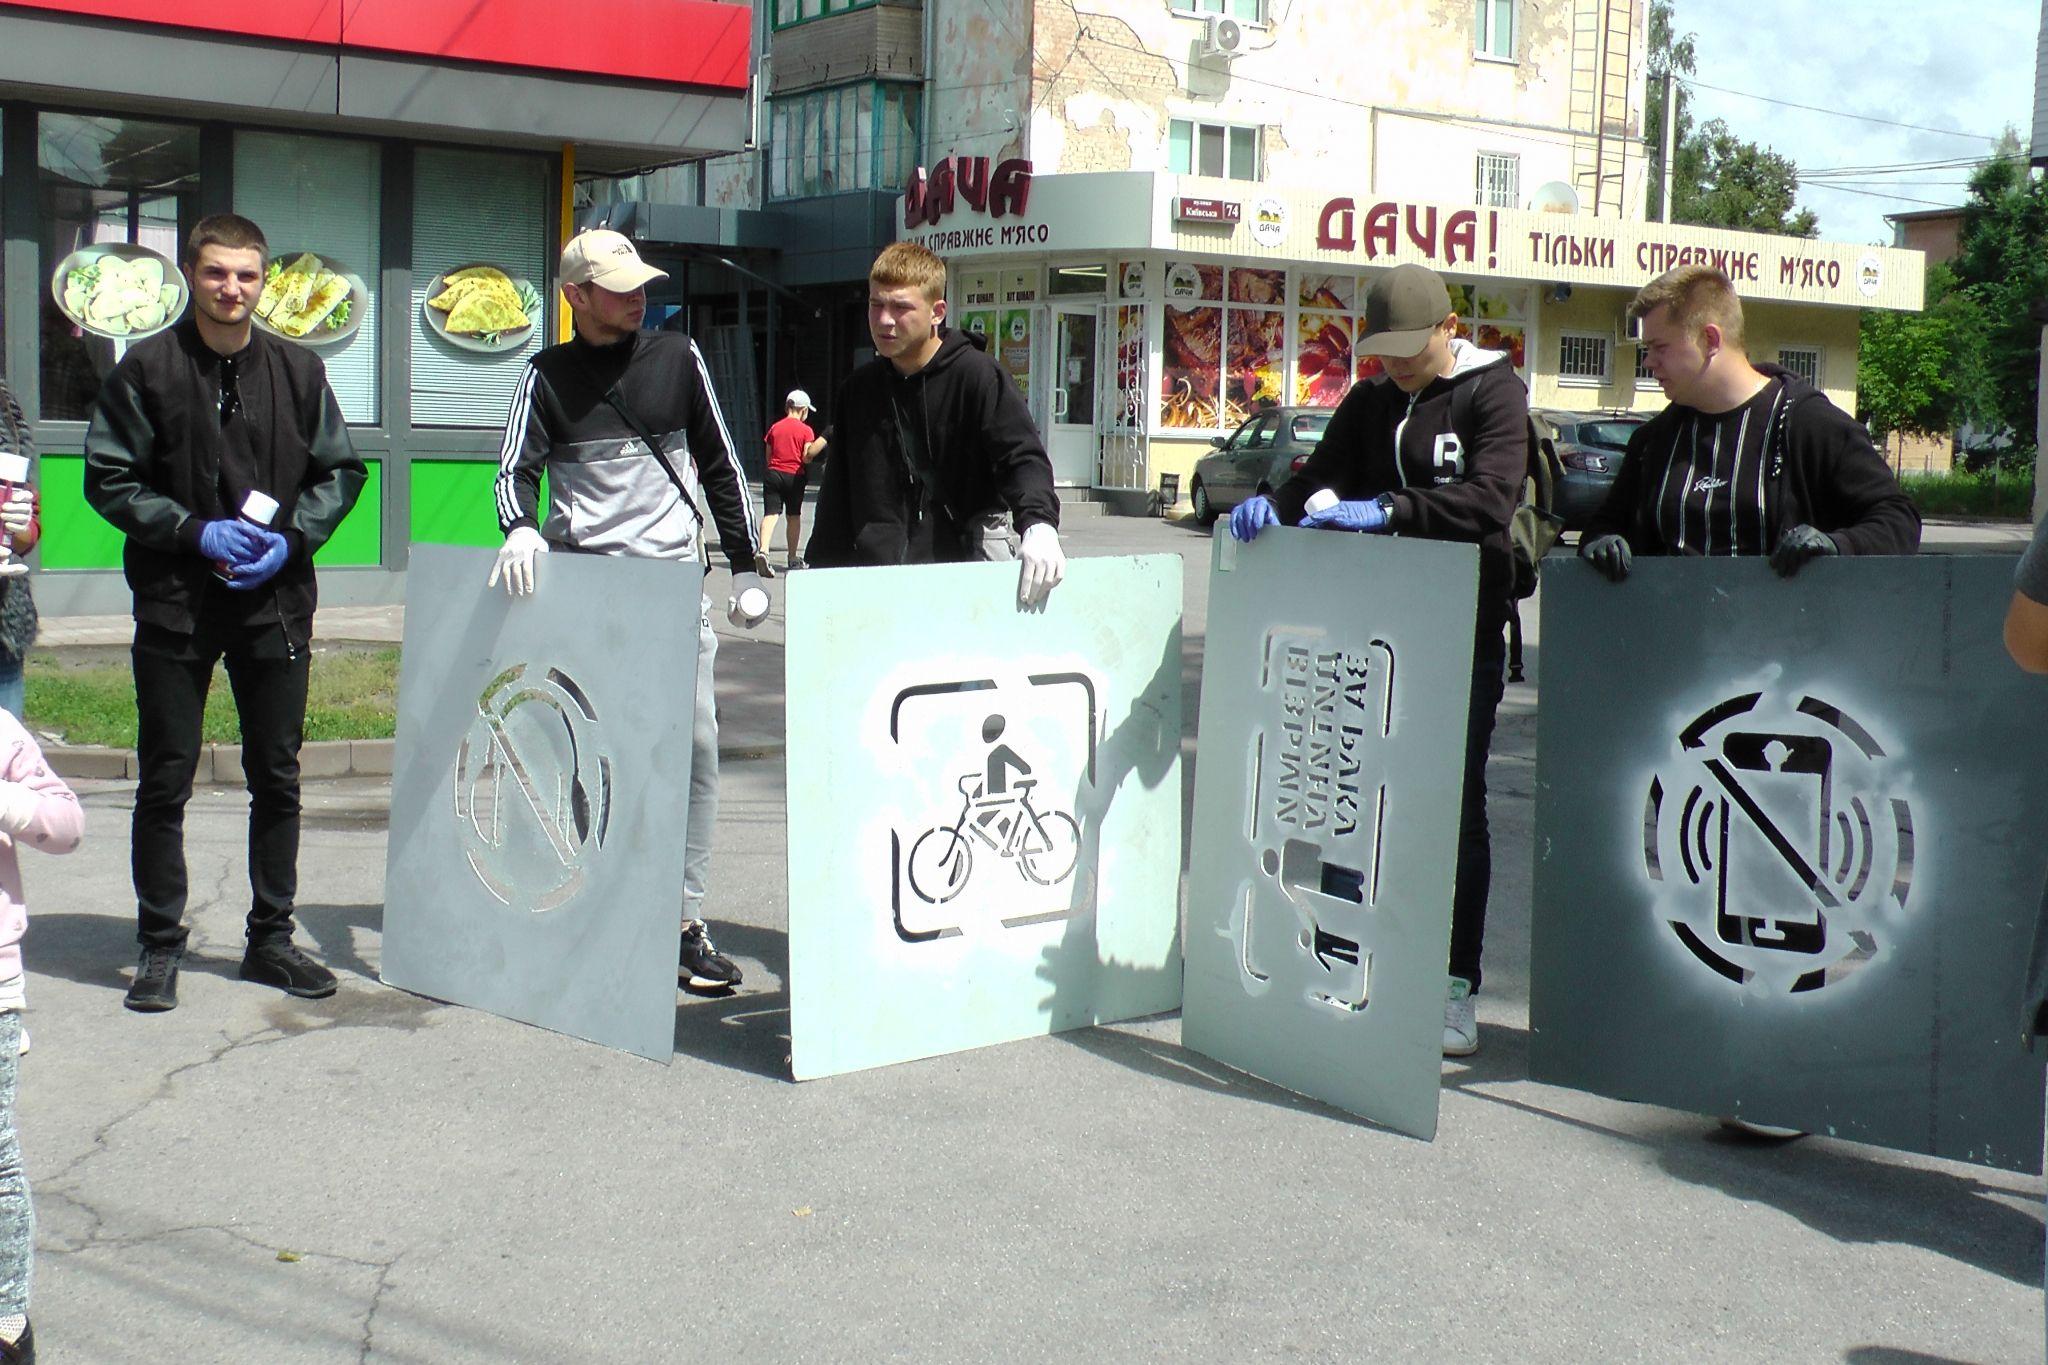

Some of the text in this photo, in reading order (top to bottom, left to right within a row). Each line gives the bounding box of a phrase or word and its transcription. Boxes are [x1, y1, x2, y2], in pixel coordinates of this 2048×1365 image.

[905, 156, 1033, 229] ДАЧА
[1185, 207, 1218, 218] Київська
[1226, 204, 1239, 218] 74
[928, 228, 993, 252] СПРАВЖНЄ
[1001, 224, 1049, 246] М'ЯСО
[1259, 223, 1280, 233] ДАЧА
[1316, 197, 1498, 269] ДАЧА!
[1528, 232, 1840, 289] ТІЛЬКИ СПРАВЖНЄ М'ЯСО
